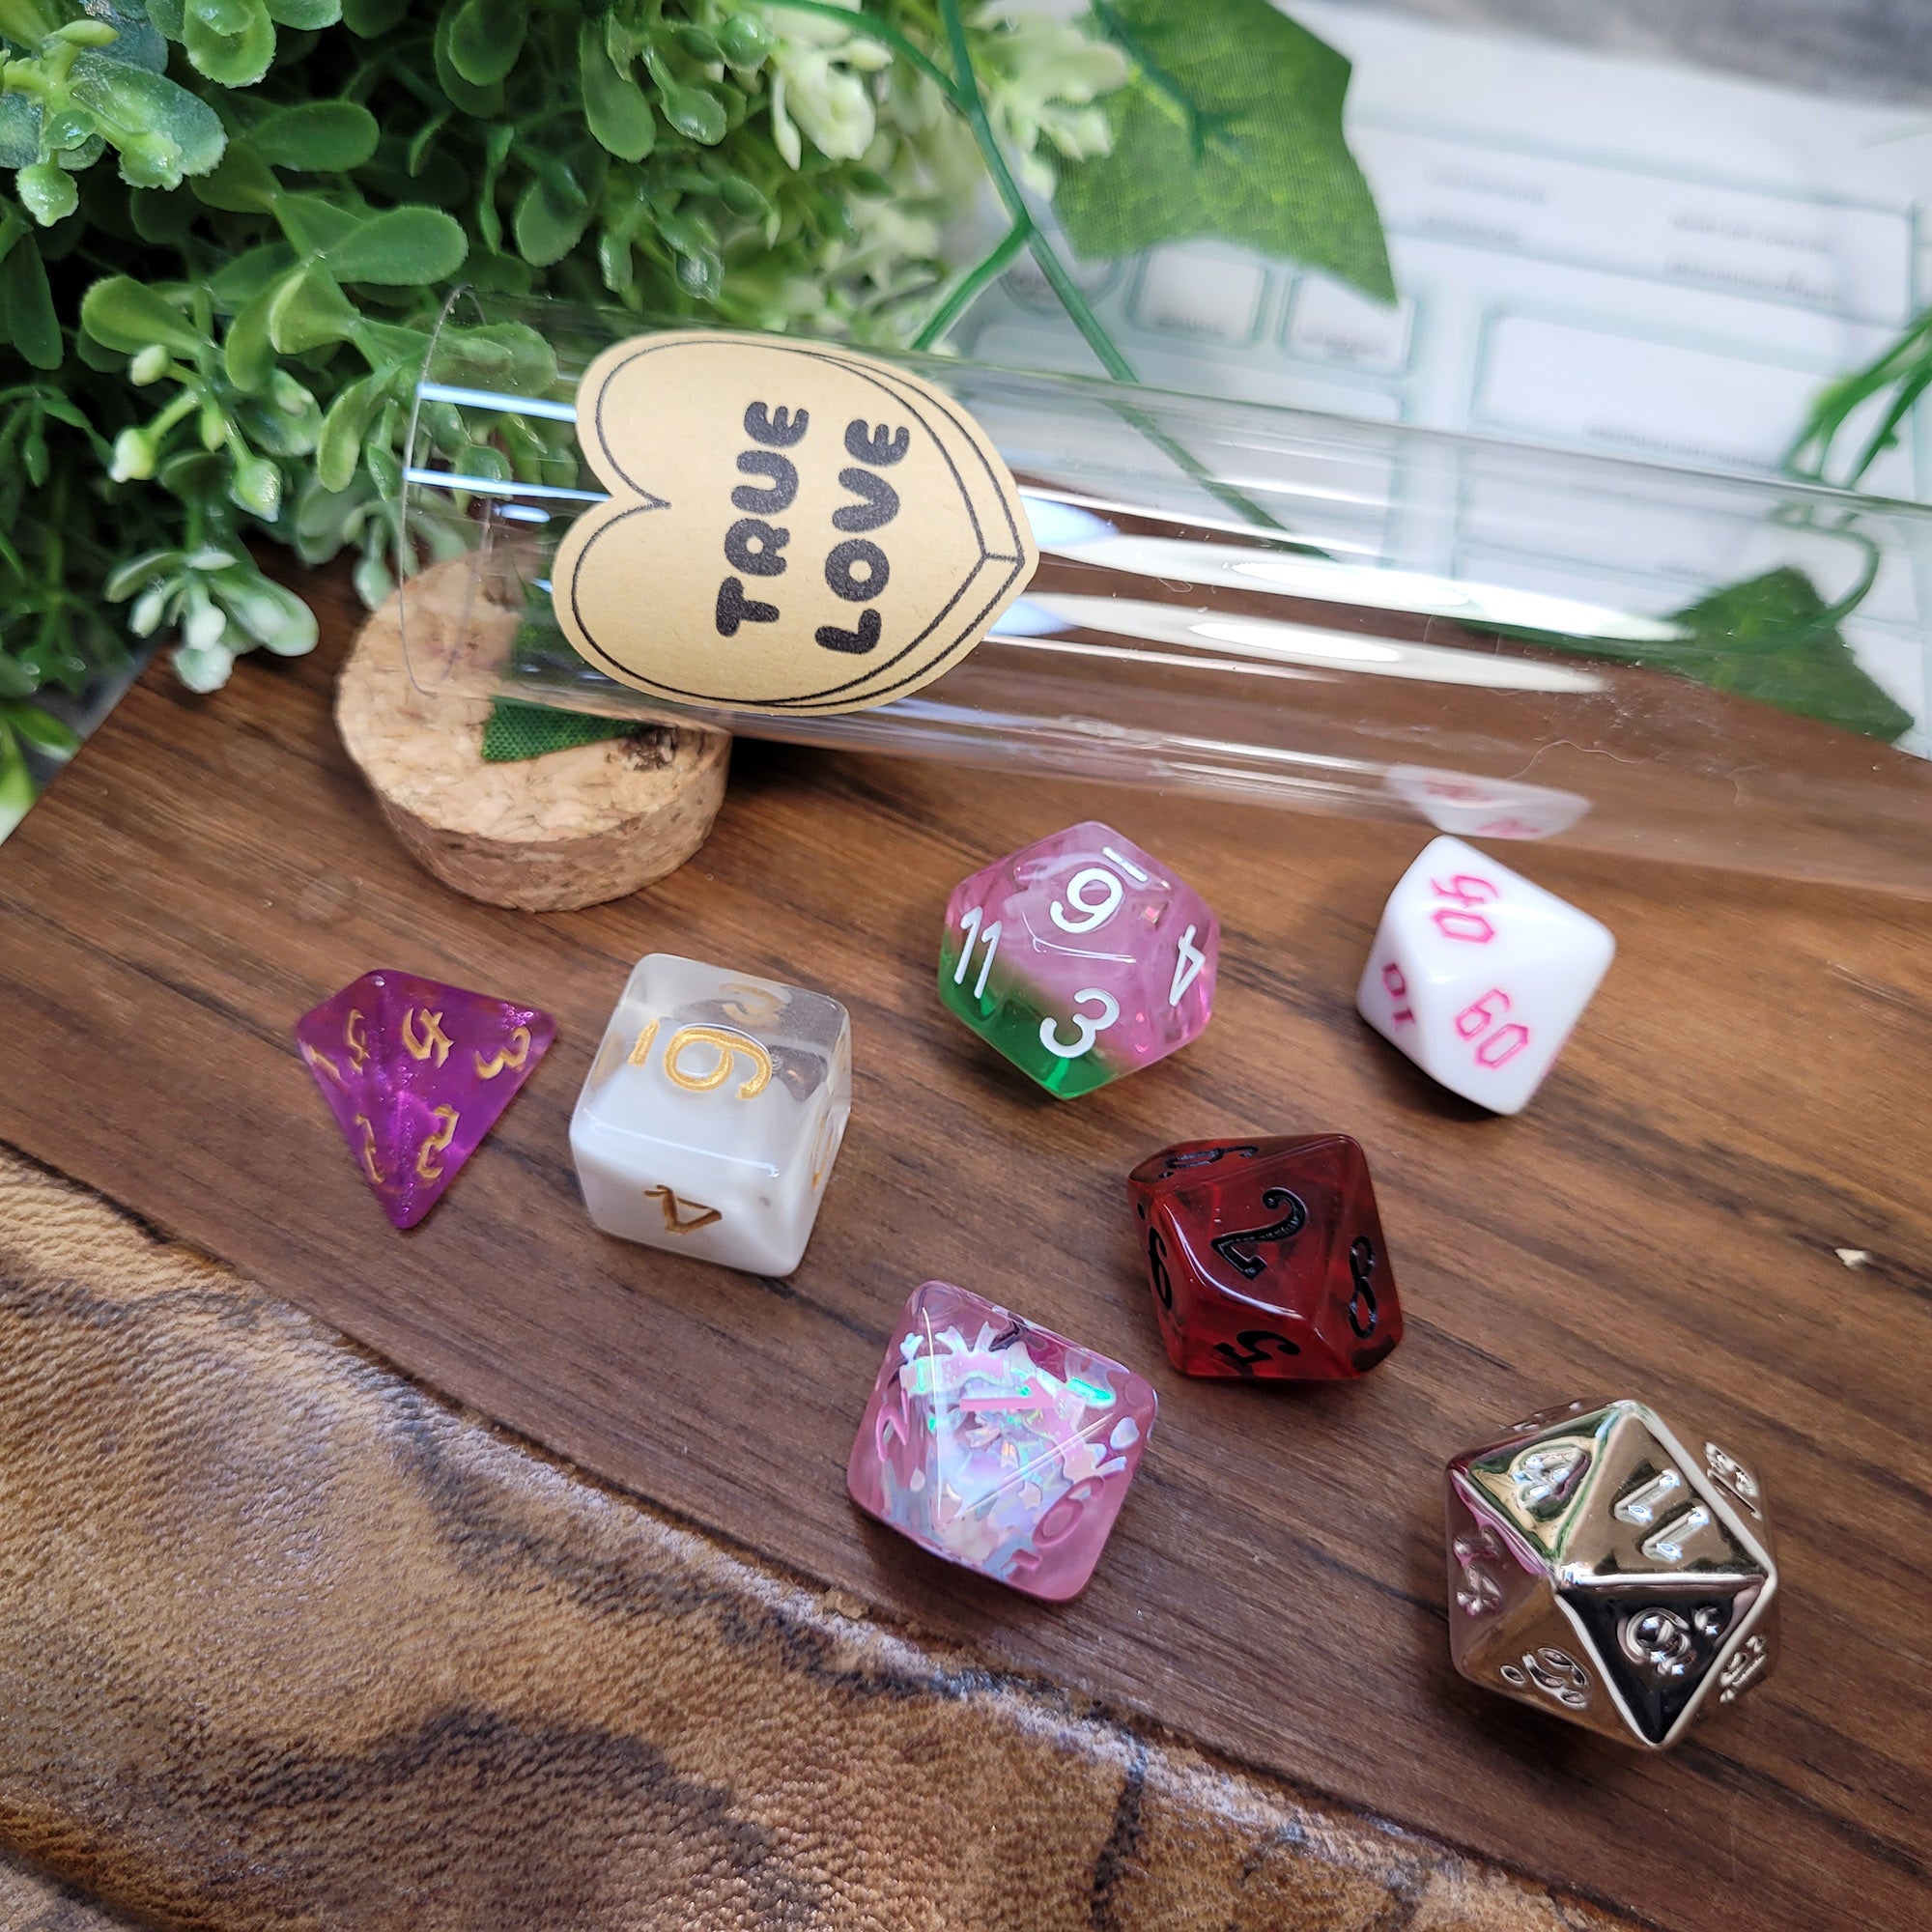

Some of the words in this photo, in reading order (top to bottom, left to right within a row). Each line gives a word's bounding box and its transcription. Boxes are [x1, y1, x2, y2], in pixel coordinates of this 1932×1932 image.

[716, 401, 810, 638] TRUE
[814, 419, 910, 655] LOVE
[953, 905, 1003, 1000] 11
[1168, 924, 1207, 1007] 4
[1039, 987, 1121, 1059] 3
[1455, 987, 1529, 1067] 60
[1210, 1186, 1309, 1281] 2
[1349, 1236, 1378, 1340] 8
[1613, 1467, 1711, 1563] 11
